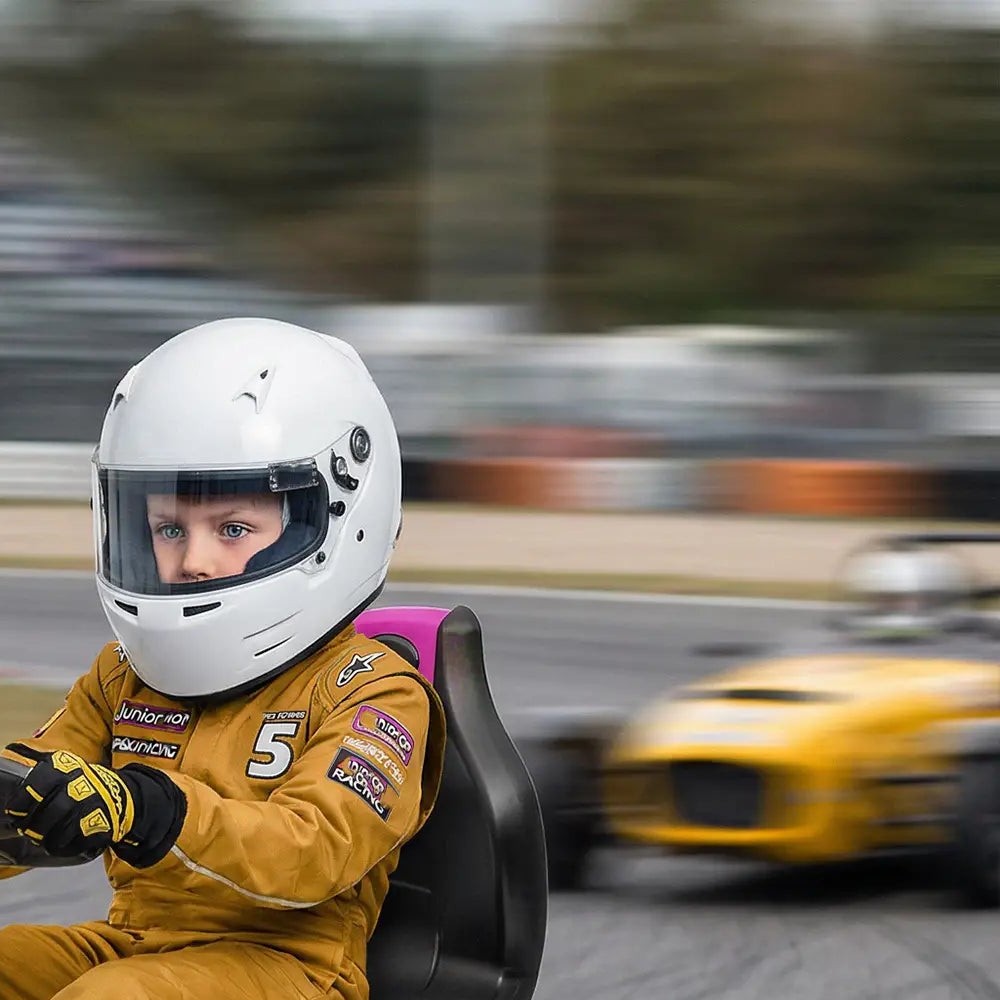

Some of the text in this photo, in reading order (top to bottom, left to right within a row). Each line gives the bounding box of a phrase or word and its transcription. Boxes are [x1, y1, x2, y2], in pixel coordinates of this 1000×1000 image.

[114, 702, 164, 725] Junior
[247, 722, 300, 778] 5
[332, 769, 385, 814] RACING
